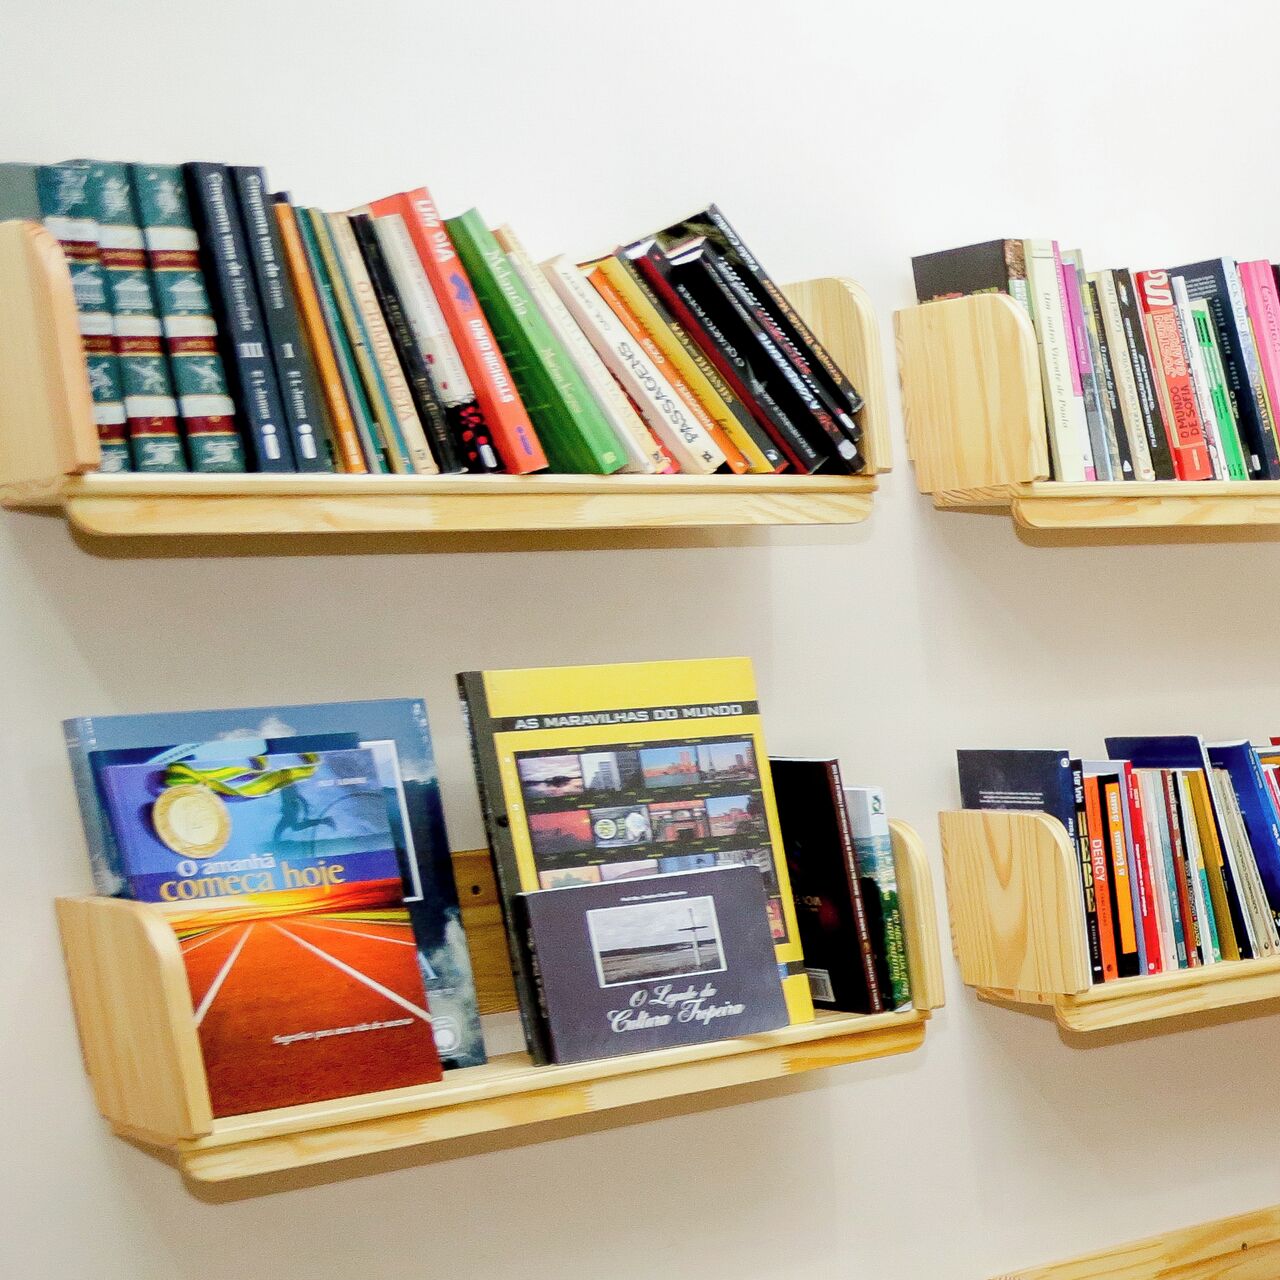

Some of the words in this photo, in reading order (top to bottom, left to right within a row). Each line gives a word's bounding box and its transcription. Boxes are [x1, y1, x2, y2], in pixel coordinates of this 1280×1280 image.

[412, 195, 441, 230] UM
[427, 230, 455, 262] DIA
[468, 317, 493, 350] DAVID
[480, 349, 517, 404] NICHOLLS
[612, 341, 701, 444] PASSAGENS
[1169, 385, 1188, 428] MUNDO
[1179, 383, 1196, 418] SOFIA
[1188, 421, 1199, 435] DE
[514, 718, 541, 731] AS
[544, 710, 649, 729] MARAVILHAS
[653, 708, 678, 721] DO
[681, 703, 742, 718] MUNDO
[1108, 791, 1119, 814] SOARES
[177, 859, 198, 877] O
[201, 853, 276, 876] amanhã
[1090, 838, 1107, 881] DERCY
[280, 861, 344, 894] hoje
